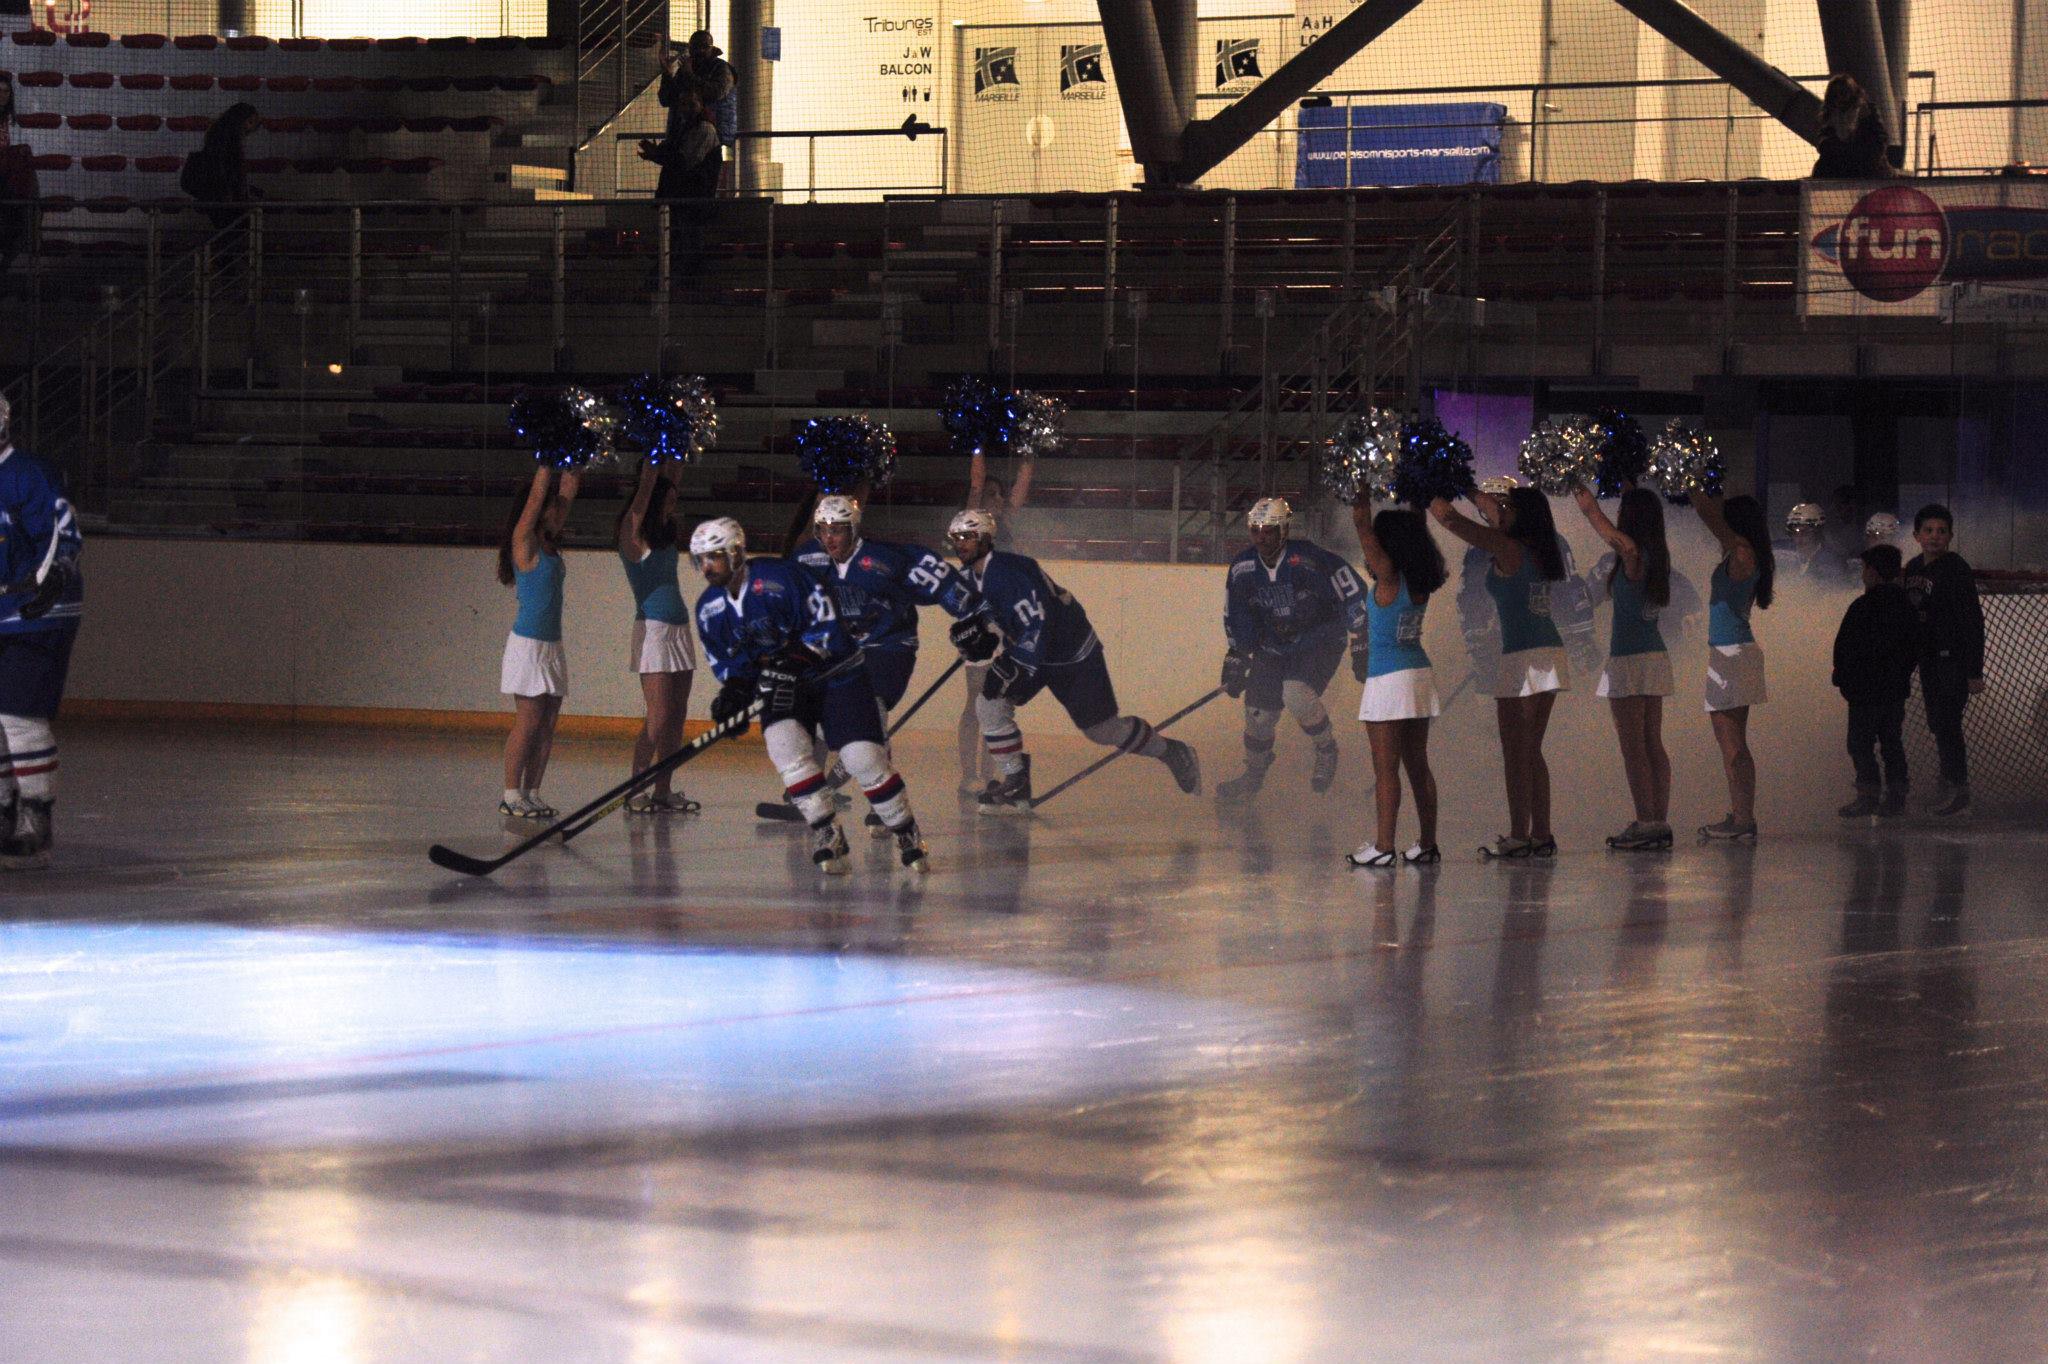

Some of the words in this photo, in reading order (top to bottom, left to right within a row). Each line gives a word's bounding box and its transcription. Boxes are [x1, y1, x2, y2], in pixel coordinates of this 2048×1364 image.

[863, 16, 933, 33] Tribunes
[920, 46, 932, 58] W
[880, 63, 932, 75] BALCON
[976, 92, 1020, 102] MARSEILLE
[1060, 90, 1106, 101] MARSEILLE
[1844, 216, 1942, 260] fun
[908, 554, 950, 595] 93
[1330, 564, 1360, 602] 19
